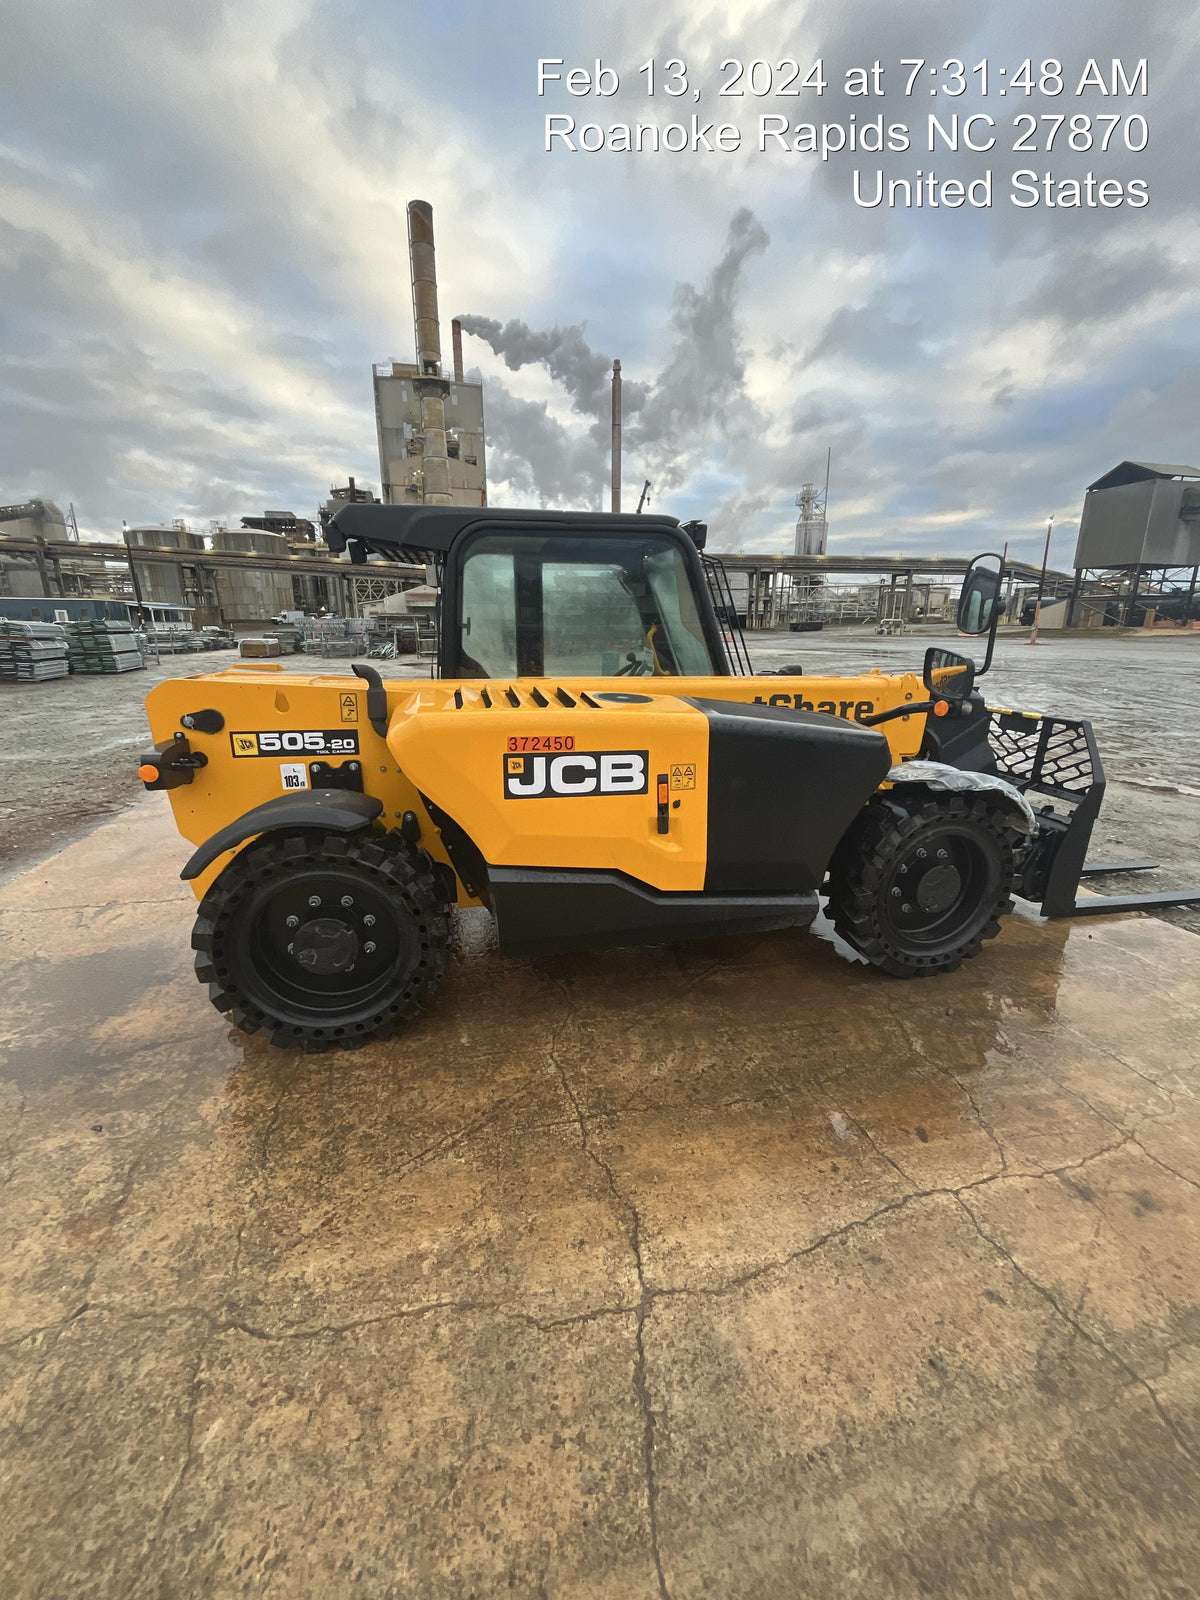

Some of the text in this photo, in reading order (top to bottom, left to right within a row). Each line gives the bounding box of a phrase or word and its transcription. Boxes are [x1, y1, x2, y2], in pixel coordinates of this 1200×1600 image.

[508, 736, 574, 751] 372450
[284, 775, 300, 787] 103
[507, 754, 645, 796] JCB
